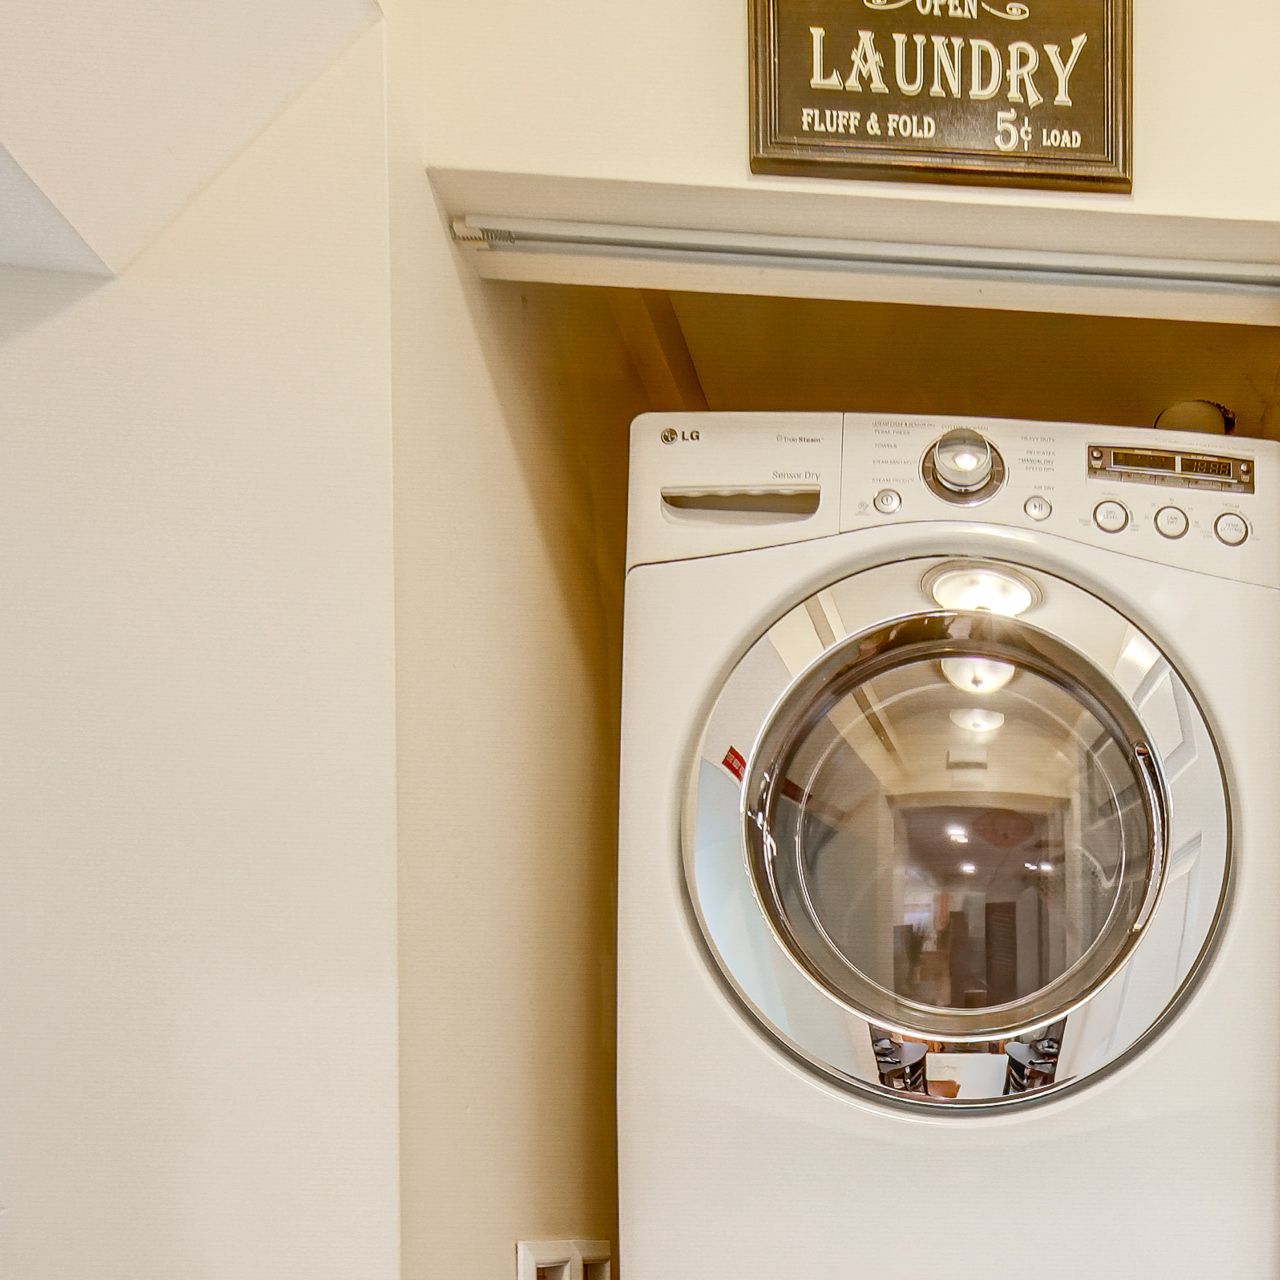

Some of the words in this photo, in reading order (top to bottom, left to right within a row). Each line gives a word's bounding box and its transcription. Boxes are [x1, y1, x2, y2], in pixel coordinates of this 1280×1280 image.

[808, 27, 1087, 109] LAUNDRY
[801, 107, 861, 135] FLUFF
[866, 112, 881, 136] &
[887, 113, 936, 139] FOLD
[1042, 128, 1082, 148] LOAD
[681, 430, 700, 441] LG
[772, 470, 802, 480] Sensor
[805, 471, 821, 482] Dry
